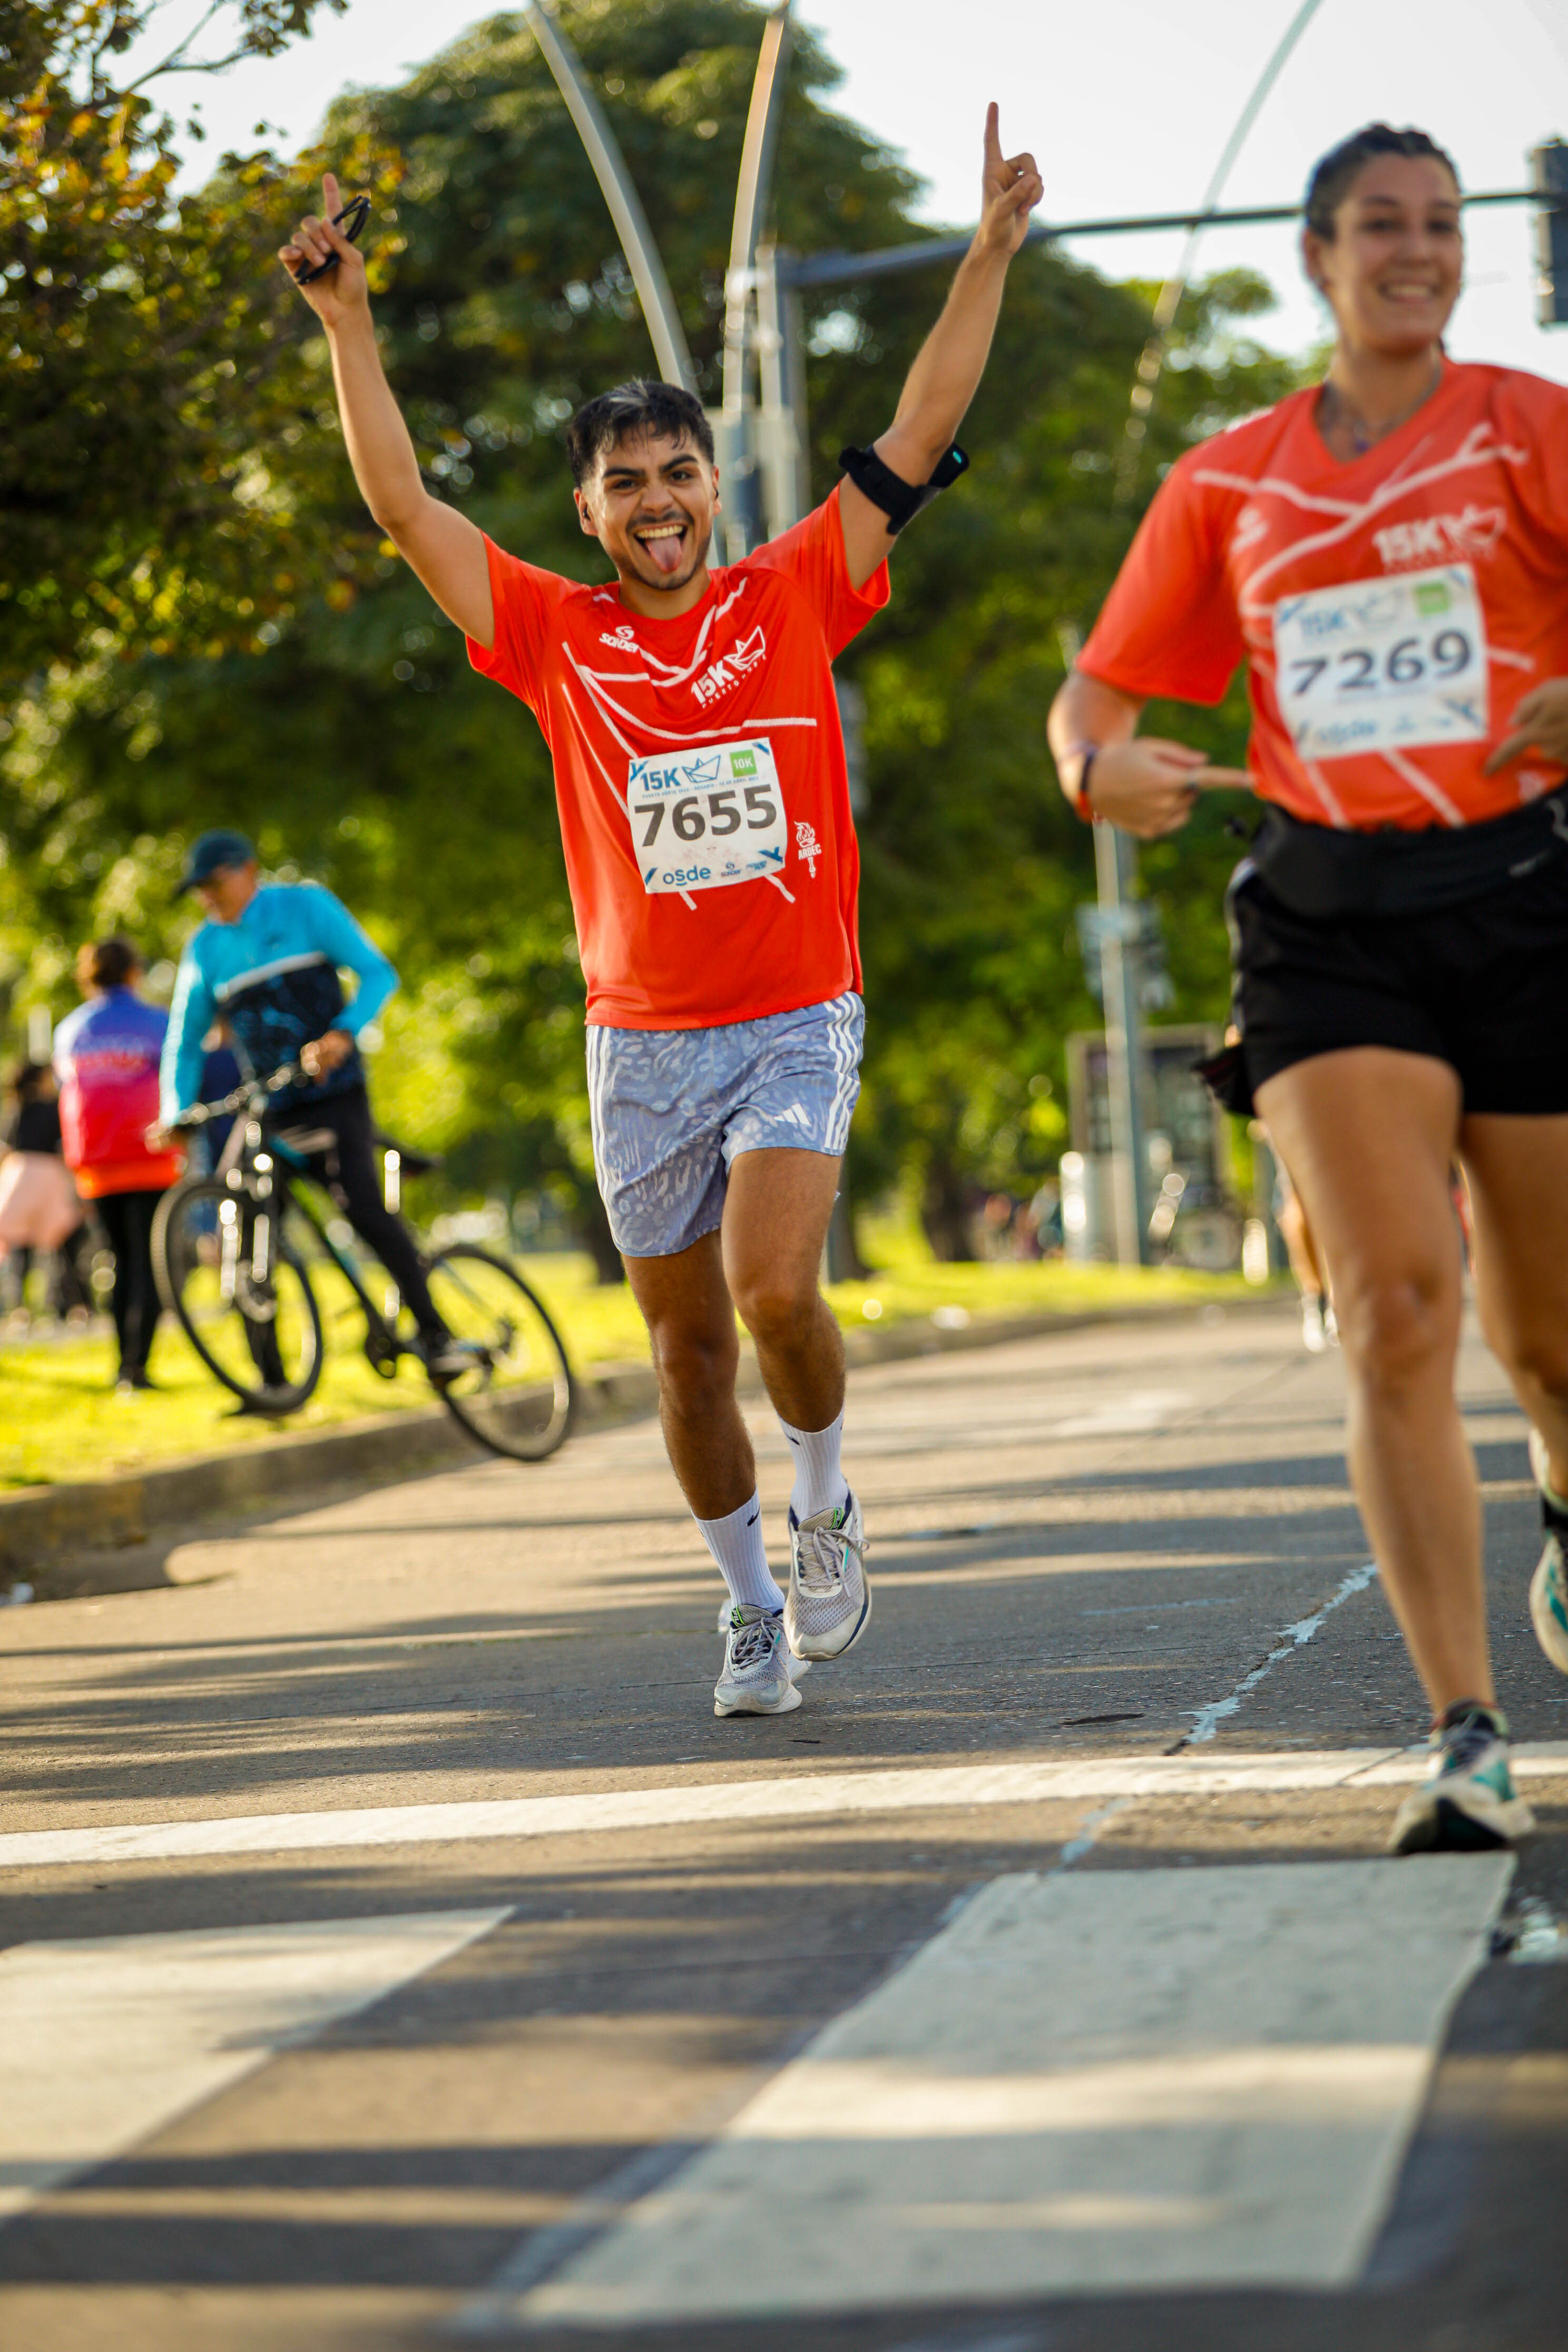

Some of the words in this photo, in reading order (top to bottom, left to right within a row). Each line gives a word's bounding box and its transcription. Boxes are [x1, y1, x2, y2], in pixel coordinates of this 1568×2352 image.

[1290, 628, 1471, 695] 7269
[691, 660, 734, 704] 15K
[641, 767, 681, 791] 15K
[733, 757, 753, 769] 10K
[634, 784, 777, 847] 7655
[798, 844, 822, 860] ARDEC
[662, 865, 711, 886] osde
